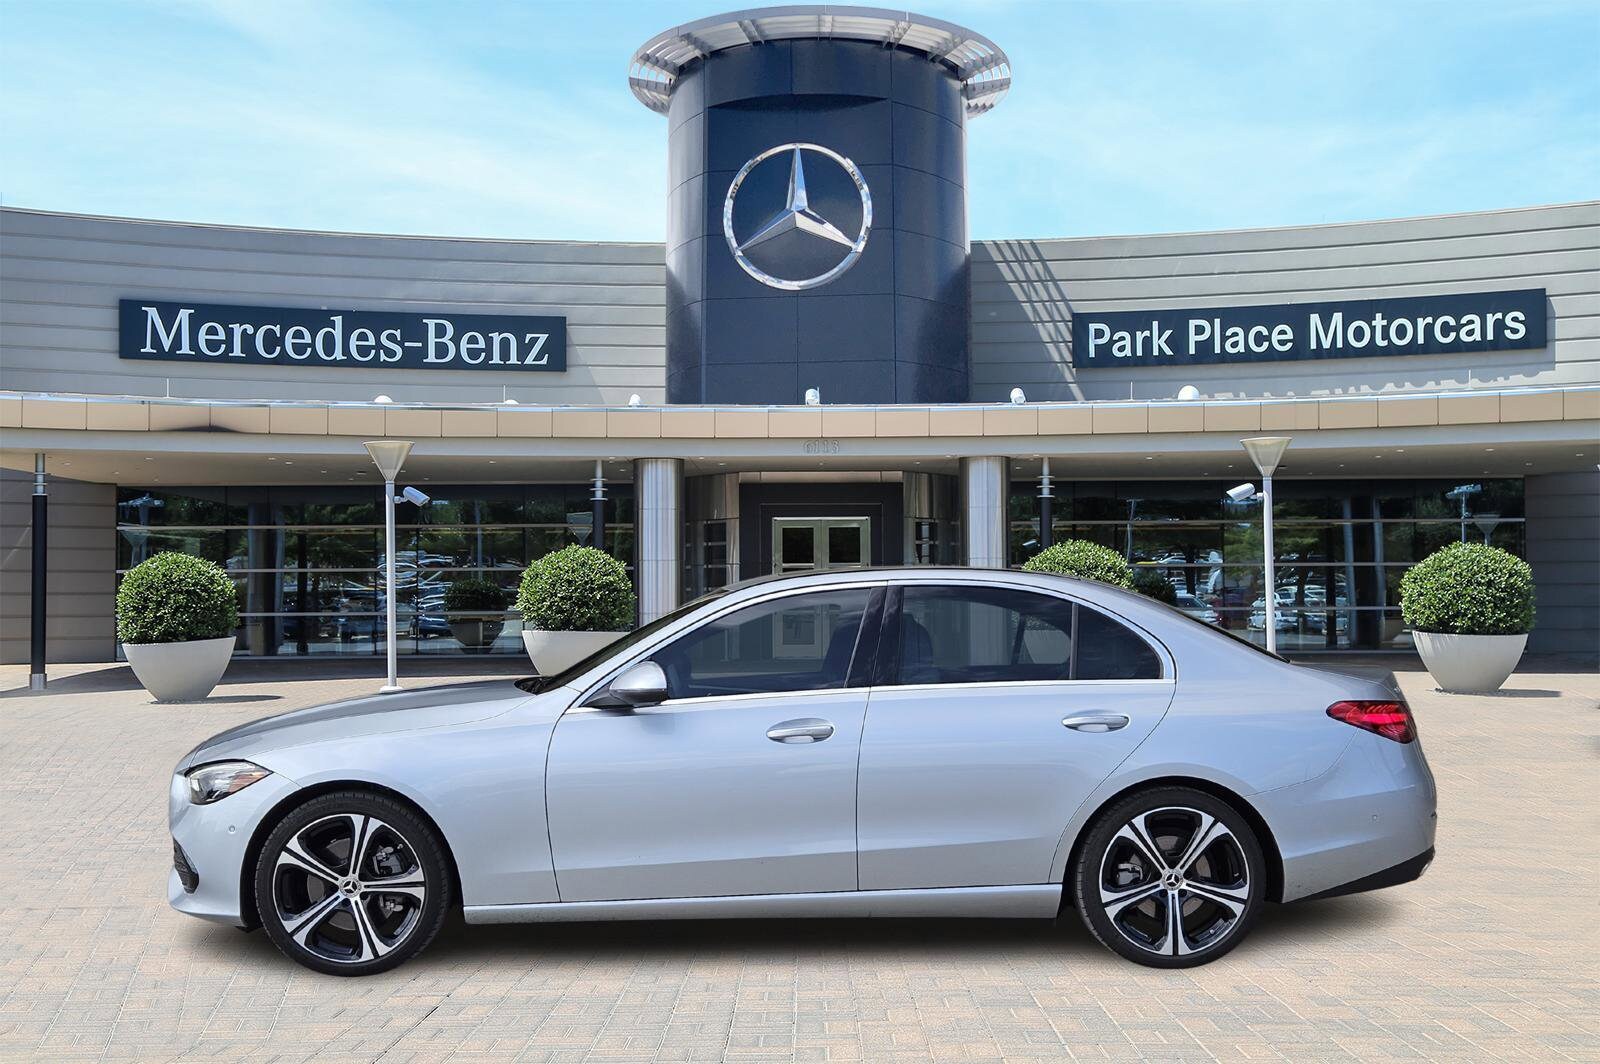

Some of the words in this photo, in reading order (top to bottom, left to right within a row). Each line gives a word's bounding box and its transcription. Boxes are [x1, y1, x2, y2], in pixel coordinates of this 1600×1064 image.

[140, 306, 549, 365] Mercedes-Benz
[1087, 320, 1174, 358] Park
[1187, 317, 1294, 355] Place
[1309, 310, 1527, 350] Motorcars
